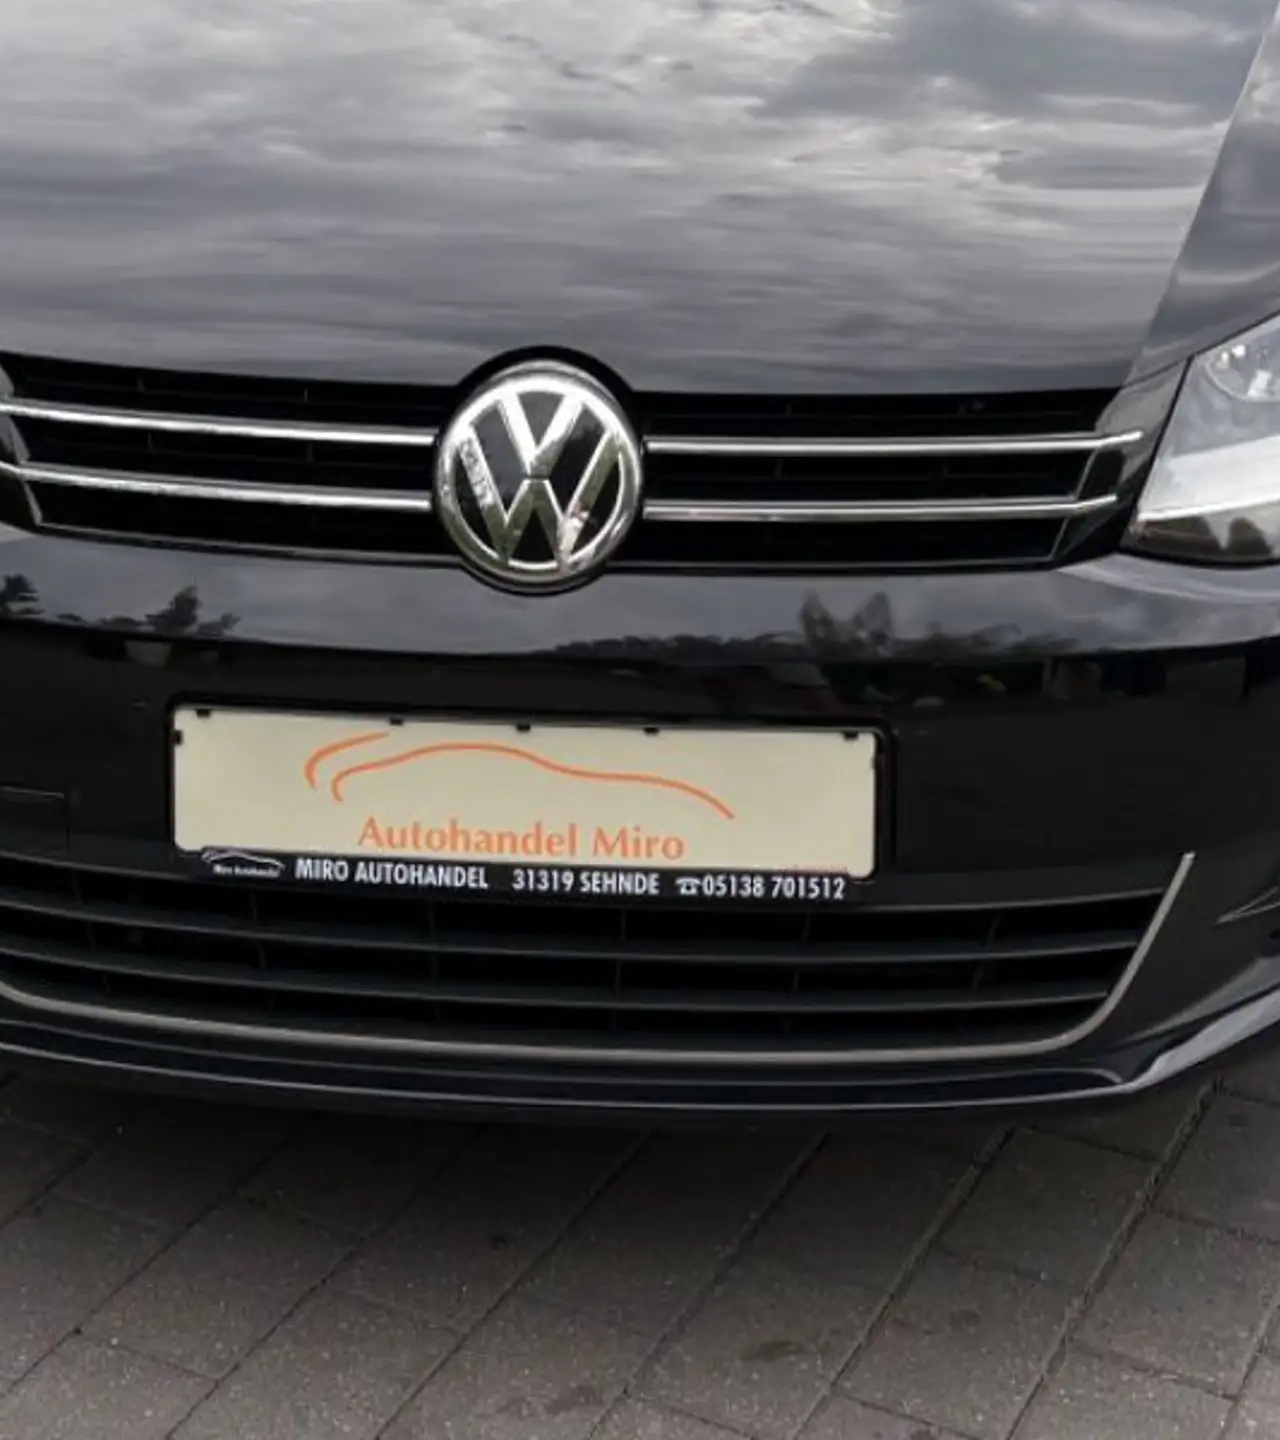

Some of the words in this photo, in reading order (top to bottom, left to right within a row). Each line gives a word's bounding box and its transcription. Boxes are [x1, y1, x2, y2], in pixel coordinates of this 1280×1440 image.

[357, 815, 578, 857] Autohandel
[591, 824, 685, 860] Miro
[294, 858, 349, 881] MIRO
[354, 861, 489, 889] AUTOHANDEL
[511, 868, 574, 892] 31319
[579, 871, 660, 895] SEHNDE
[770, 875, 846, 900] 701512
